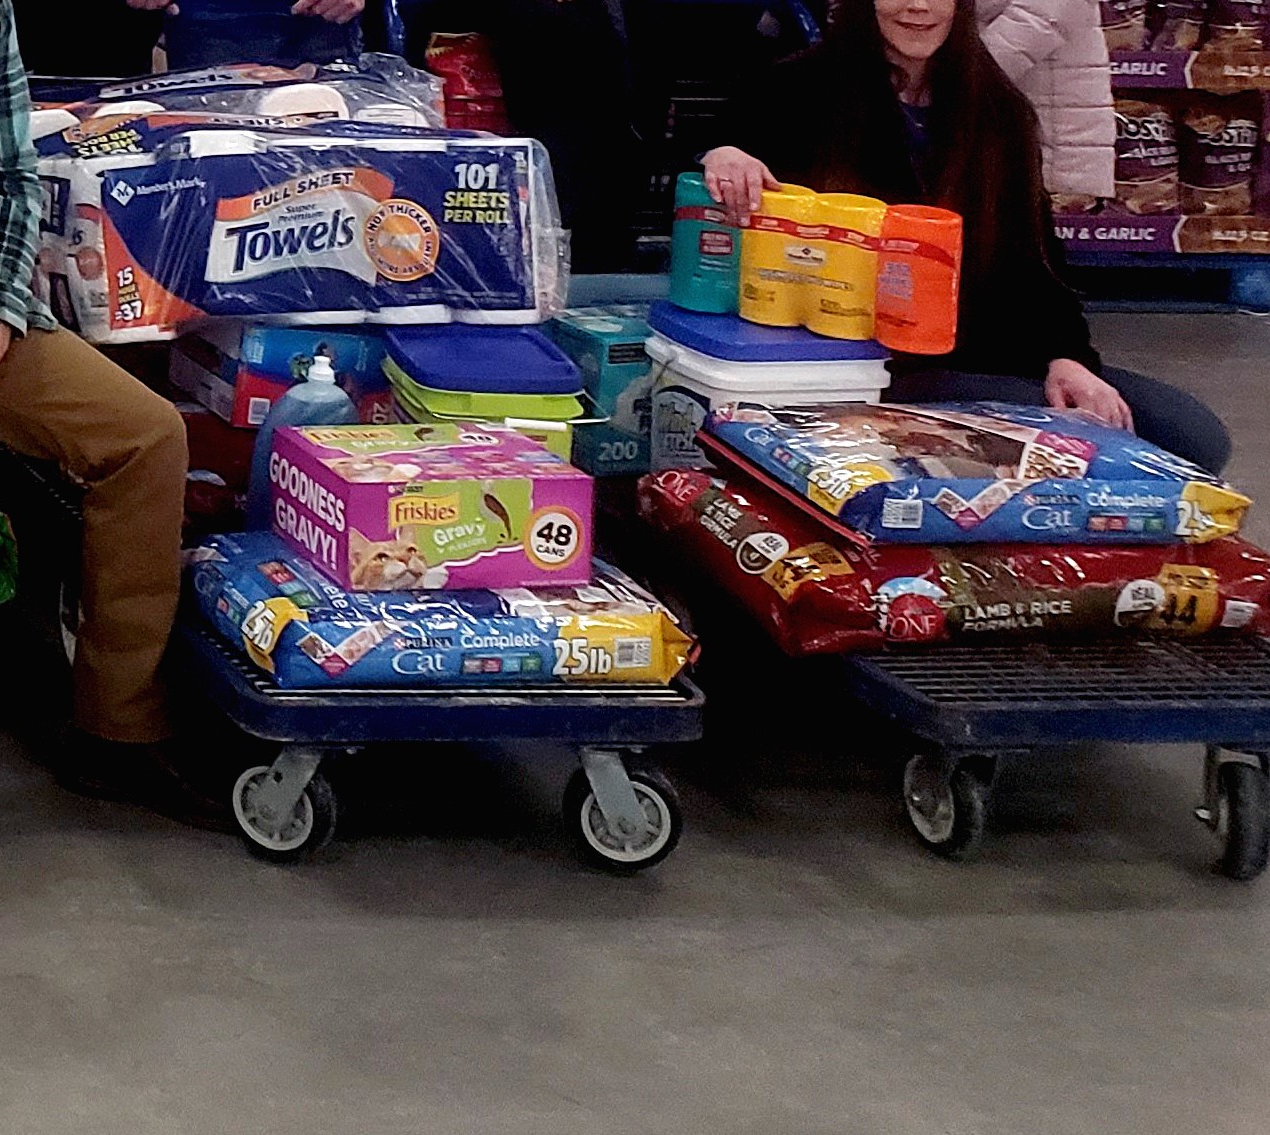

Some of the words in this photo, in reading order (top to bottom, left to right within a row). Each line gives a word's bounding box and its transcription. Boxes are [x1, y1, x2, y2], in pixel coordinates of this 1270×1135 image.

[1111, 62, 1168, 75] GARLIC
[454, 163, 500, 189] 101
[252, 187, 290, 211] FULL
[296, 170, 354, 194] SHEET
[442, 191, 511, 209] SHEETS
[286, 202, 317, 214] Super
[388, 204, 432, 233] THICKER
[444, 209, 472, 223] PER
[475, 210, 512, 224] ROLL
[224, 208, 355, 274] Towels
[1078, 227, 1091, 240] &
[1094, 227, 1156, 241] GARLIC
[117, 267, 134, 286] 15
[598, 440, 639, 462] 200
[269, 451, 346, 532] GOODNESS
[657, 470, 697, 502] ONE
[395, 501, 456, 522] Friskies
[1085, 492, 1166, 508] Complete
[1021, 505, 1073, 530] Cat
[275, 497, 338, 570] GRAVY!
[433, 520, 486, 545] Gravy
[536, 522, 573, 546] 48
[535, 545, 566, 558] CANS
[964, 602, 1012, 621] LAMB
[1033, 601, 1073, 615] RICE
[241, 601, 274, 647] 25lb
[888, 615, 936, 639] ONE
[962, 616, 1044, 632] FORMULA
[405, 636, 453, 648] PURINA
[460, 633, 540, 649] Complete
[391, 649, 446, 675] Cat
[552, 639, 612, 676] 25lb
